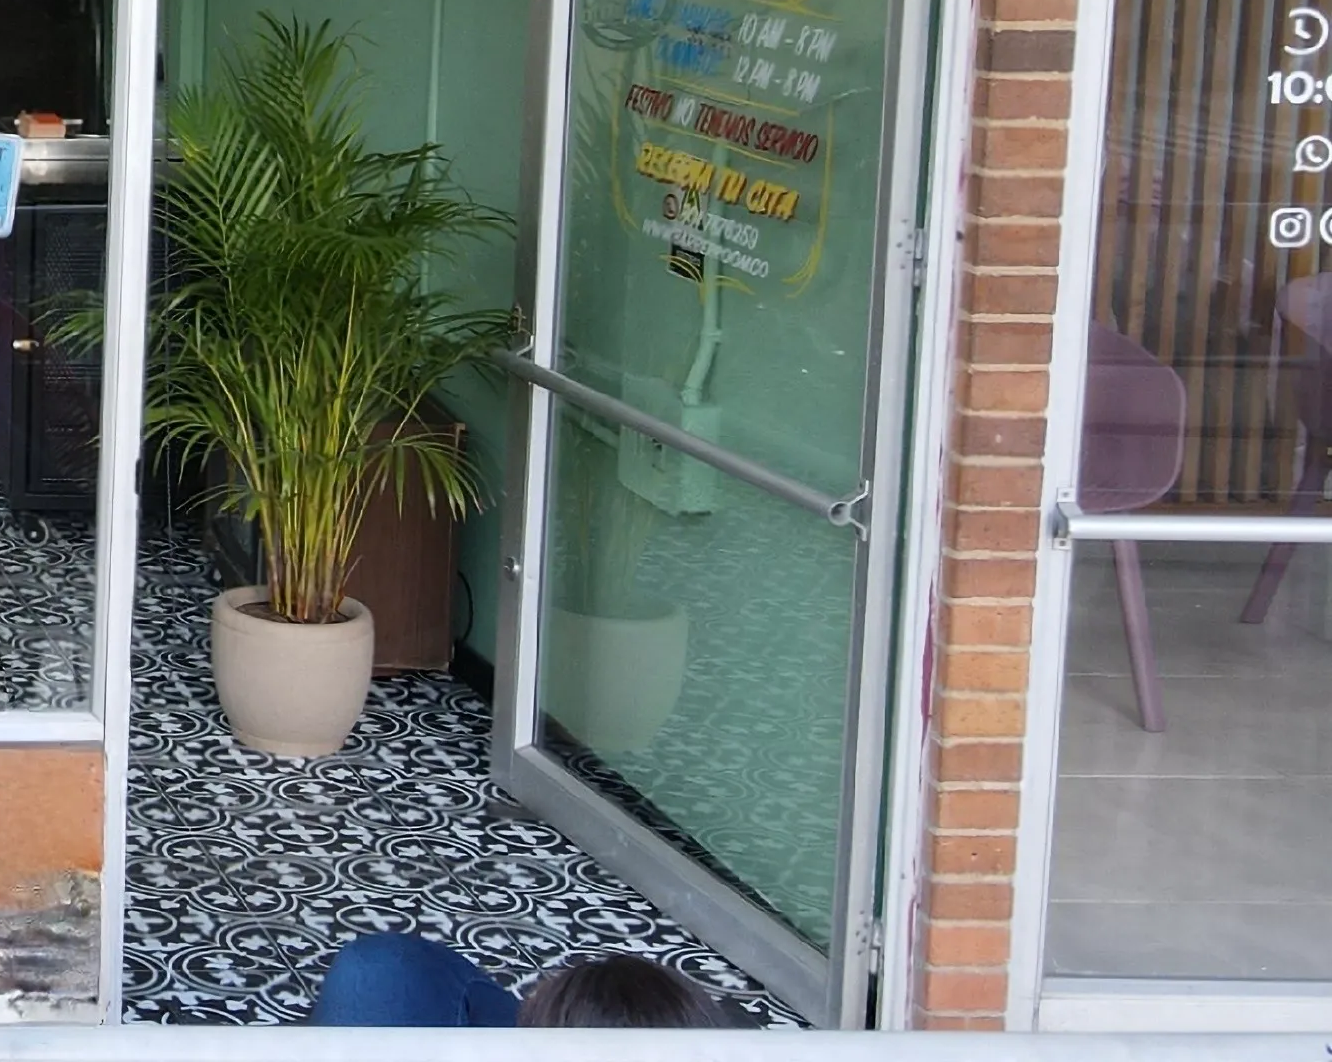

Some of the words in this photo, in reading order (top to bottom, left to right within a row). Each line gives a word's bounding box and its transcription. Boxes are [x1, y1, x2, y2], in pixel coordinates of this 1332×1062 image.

[737, 13, 758, 44] 10
[756, 17, 787, 51] AM
[794, 25, 810, 57] 8
[806, 28, 838, 63] PM
[733, 55, 751, 84] 12
[782, 68, 798, 97] 8
[793, 70, 822, 104] PM
[1268, 70, 1332, 105] 10:
[671, 96, 696, 127] NO
[715, 167, 748, 205] TU
[746, 179, 801, 223] CITA
